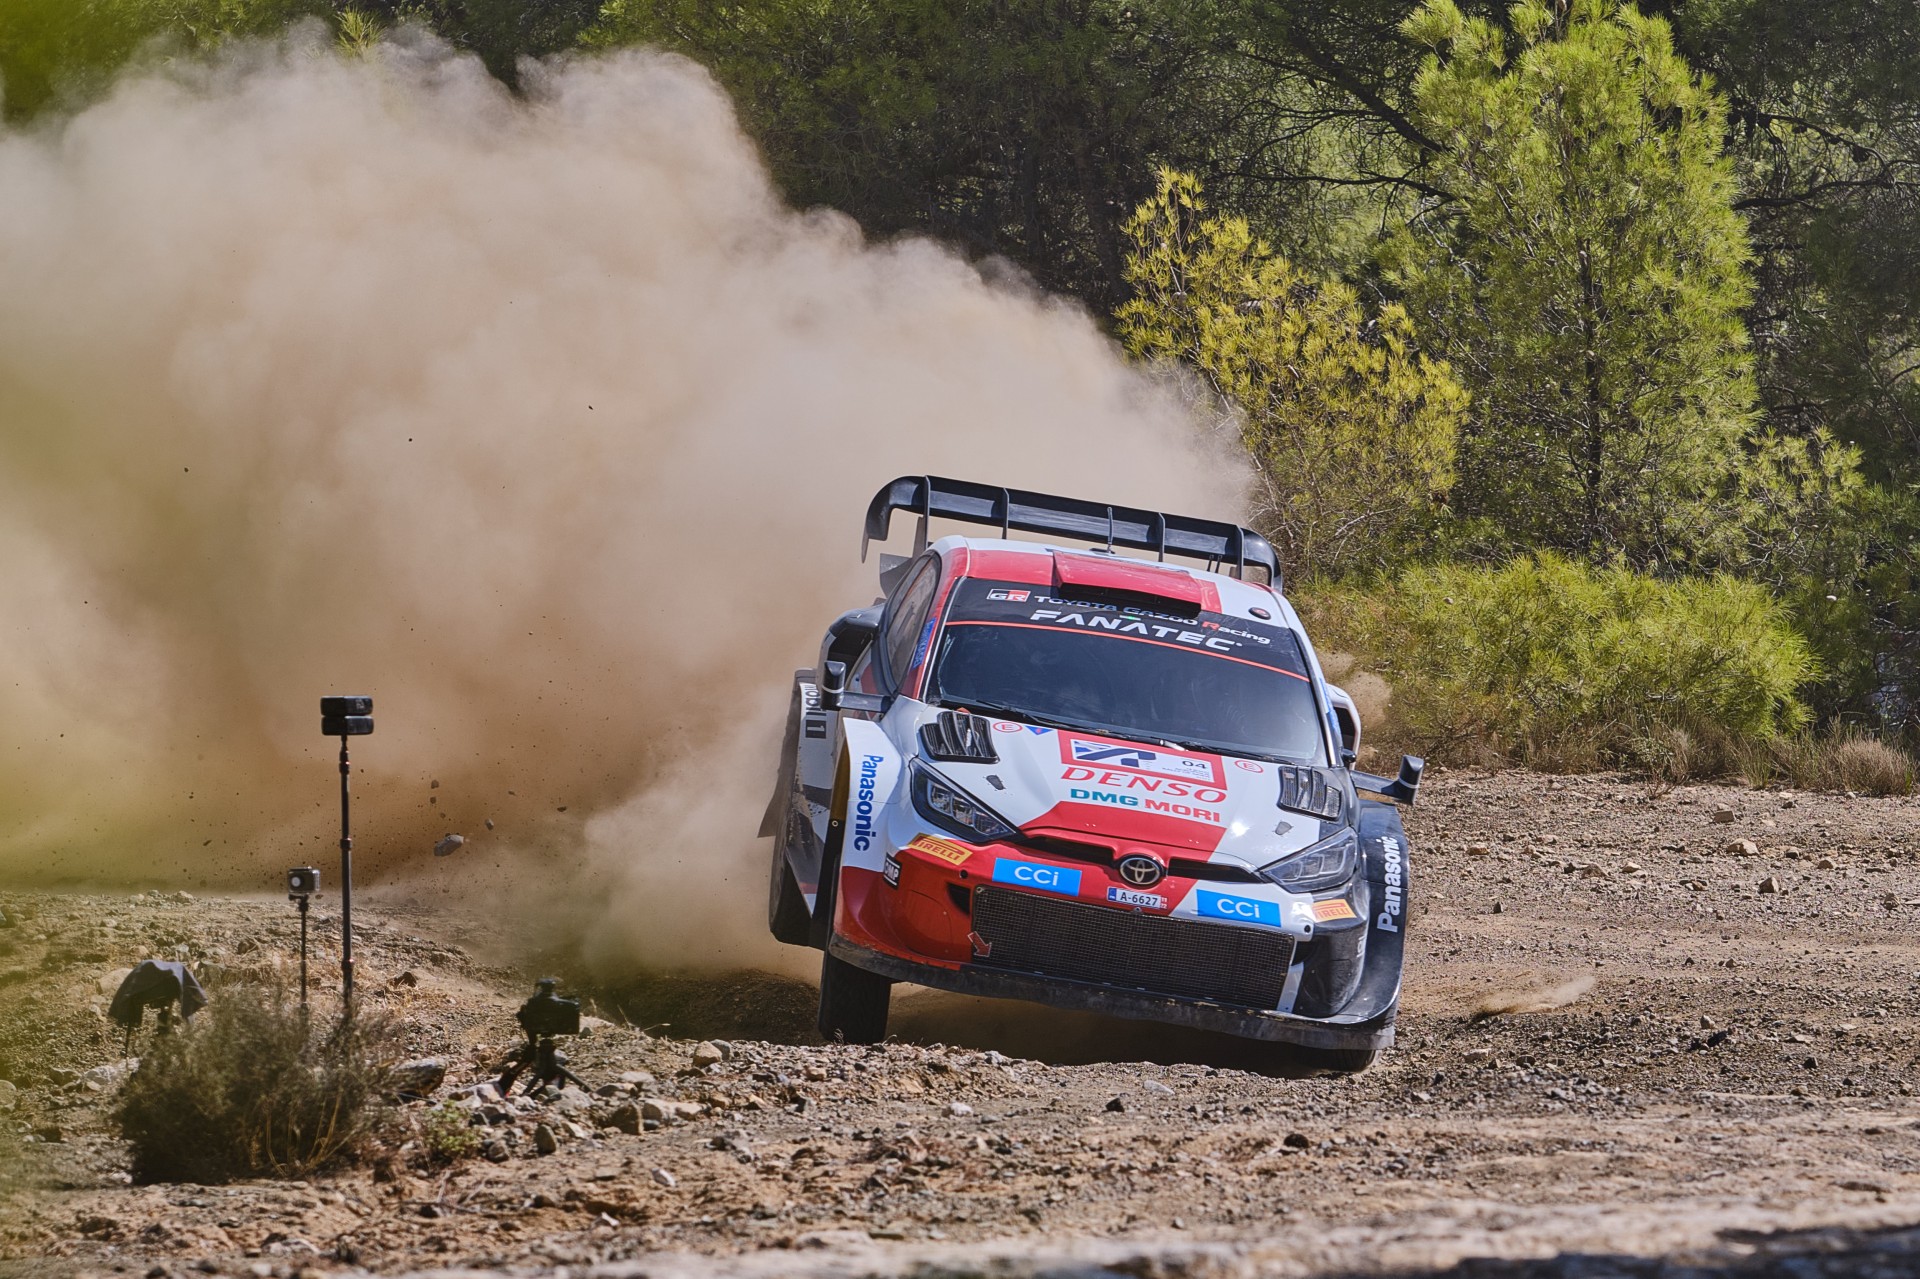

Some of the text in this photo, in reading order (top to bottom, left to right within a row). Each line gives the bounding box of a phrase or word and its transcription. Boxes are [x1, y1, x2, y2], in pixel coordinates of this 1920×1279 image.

[988, 591, 1028, 602] GR
[1030, 609, 1236, 651] FANATEC
[1034, 595, 1271, 645] TOYOTA GAZOO Racing
[1182, 760, 1207, 769] 04
[1060, 766, 1228, 803] DENSO
[854, 754, 884, 852] Panasonic
[1070, 788, 1221, 823] DMG MORI
[911, 835, 966, 861] PIRELLI
[1014, 866, 1060, 886] CCi
[1376, 836, 1401, 933] Panasonic
[1120, 892, 1158, 906] A-6627
[1216, 898, 1260, 918] CCi
